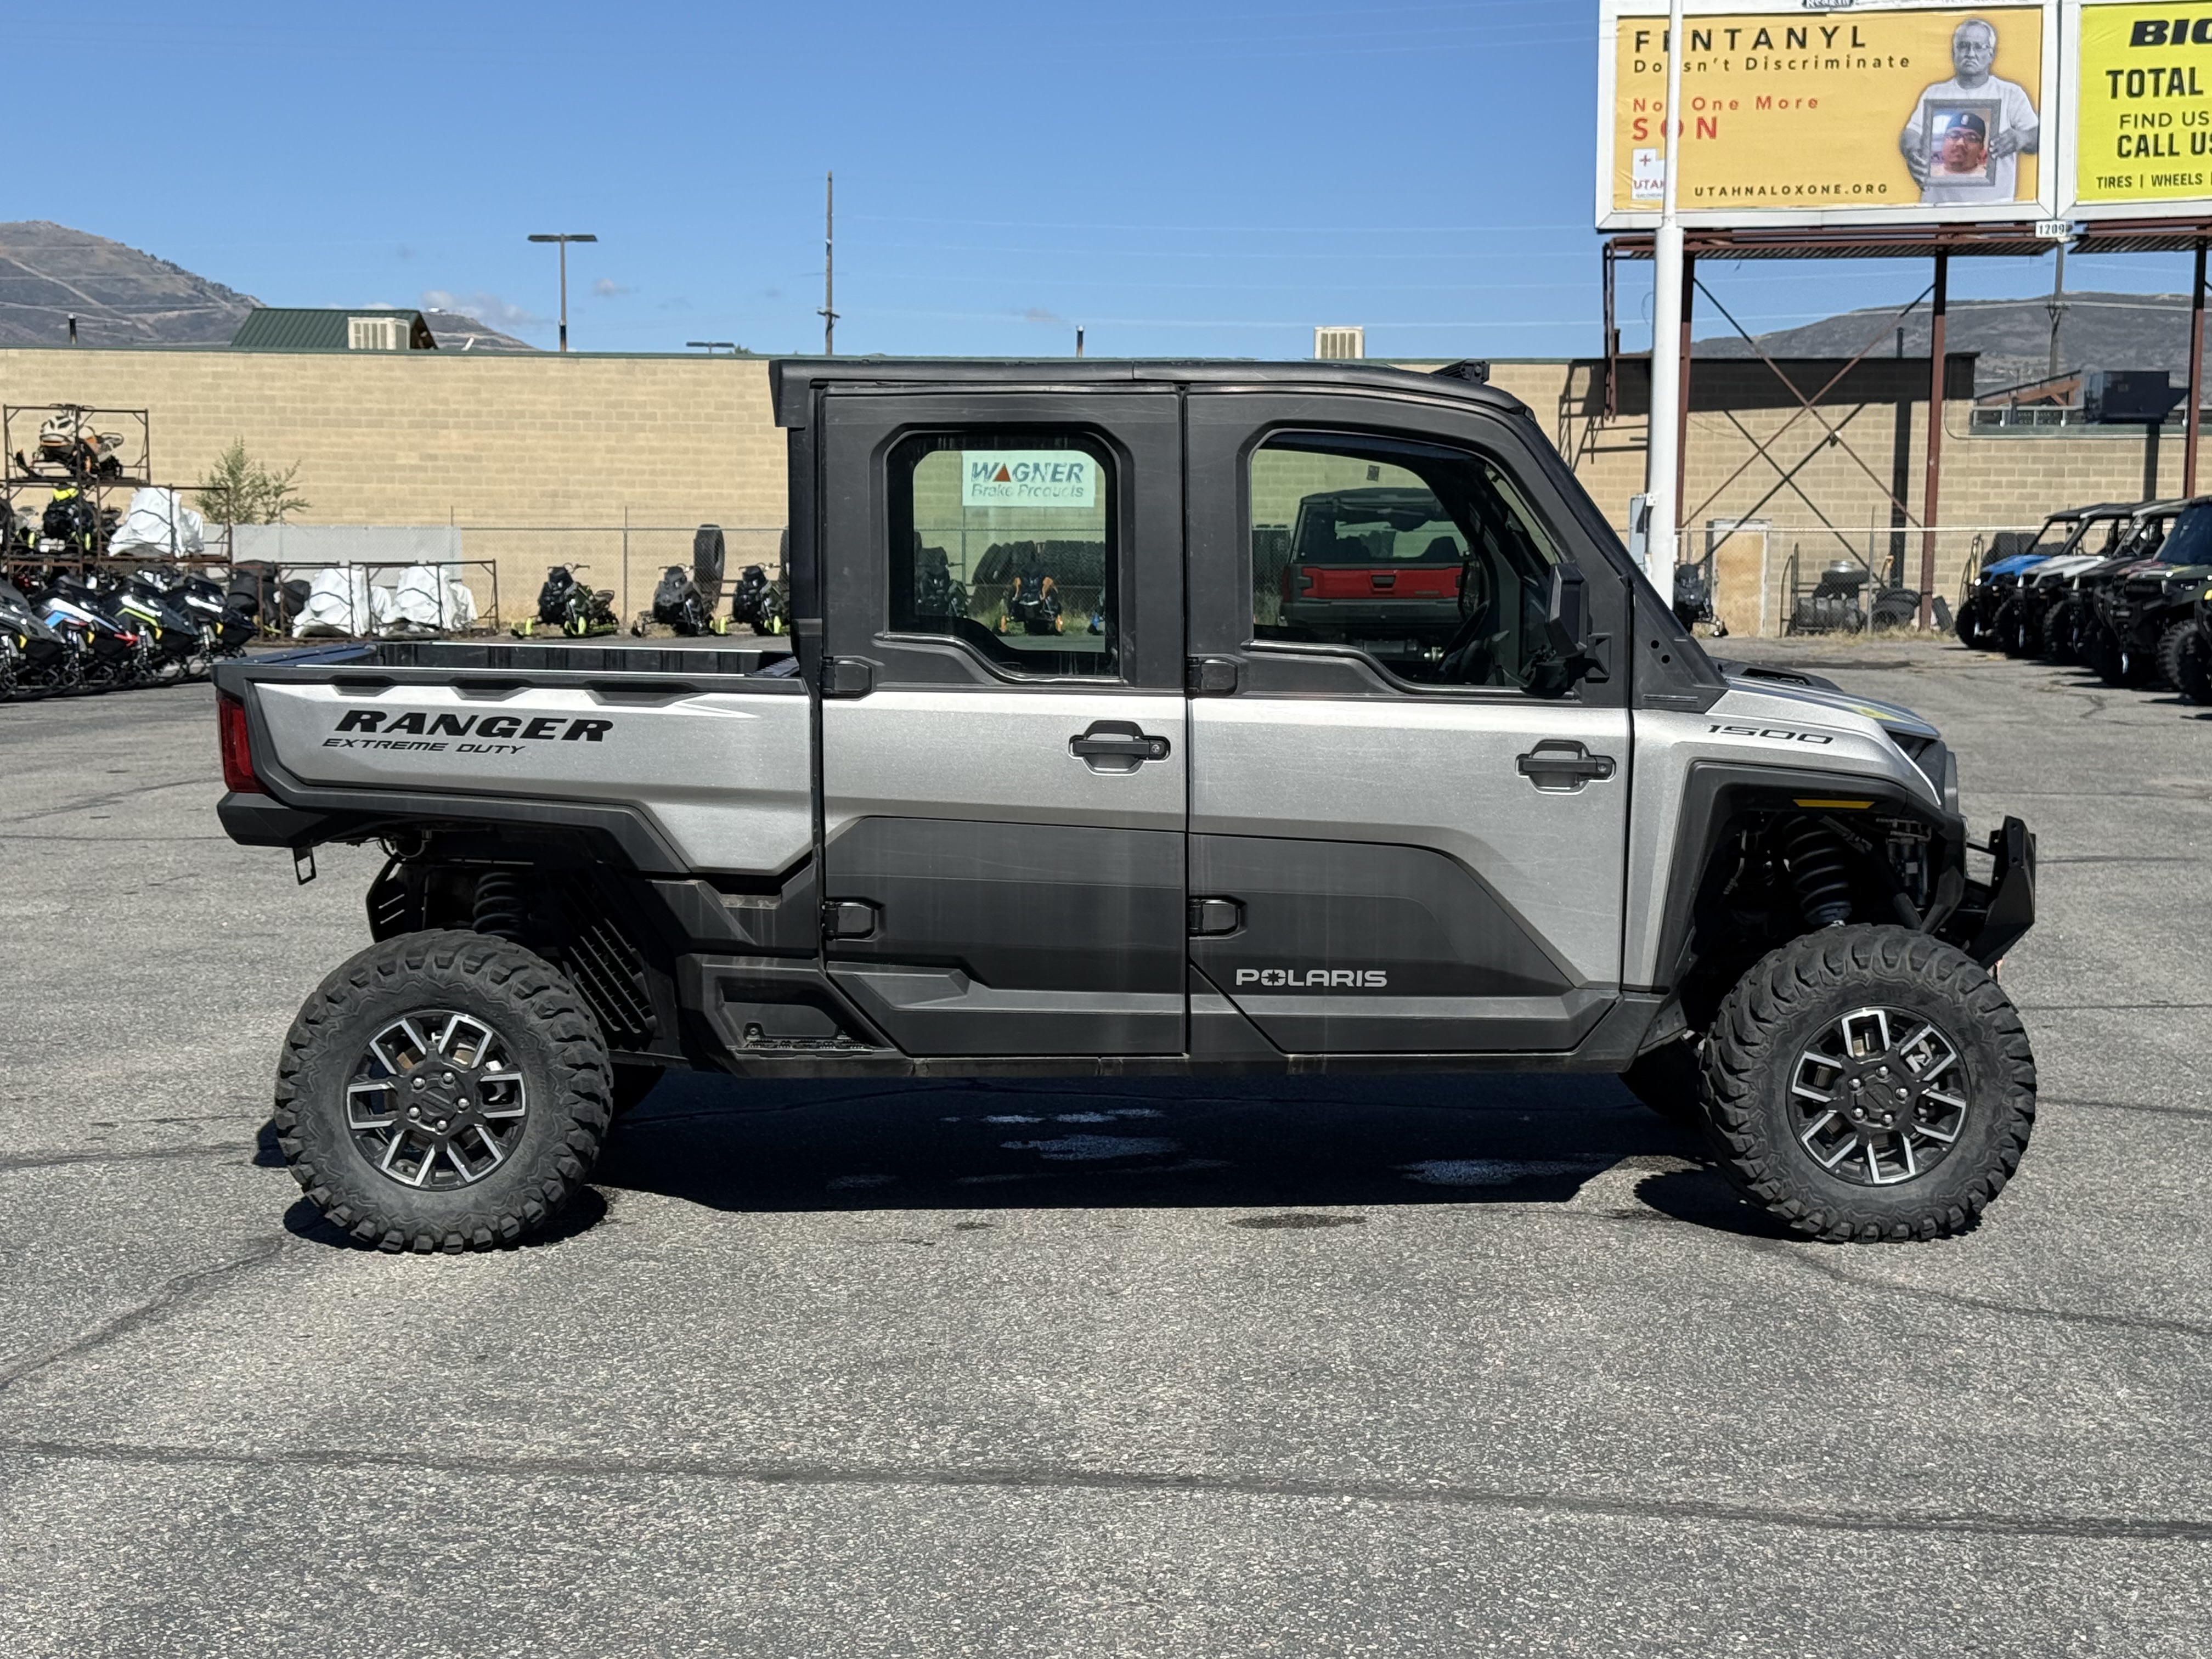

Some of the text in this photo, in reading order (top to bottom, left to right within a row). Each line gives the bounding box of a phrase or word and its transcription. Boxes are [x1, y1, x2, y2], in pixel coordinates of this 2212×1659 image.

[1634, 54, 1910, 73] Dosn't Discriminate
[2106, 66, 2204, 99] TOTAL
[1633, 95, 1819, 112] No One More
[2119, 110, 2210, 129] FIND US
[2117, 132, 2180, 159] CALL
[1694, 184, 1888, 197] UTAHNALOXONE.ORG
[2096, 175, 2133, 190] TIRES
[2151, 172, 2203, 187] WHEELS
[2039, 223, 2065, 235] 1209
[970, 462, 1085, 483] WAGNER
[334, 709, 614, 742] RANGER
[1707, 724, 1834, 744] 1500
[321, 738, 526, 755] EXTREME DUTY
[1235, 968, 1388, 988] POLARIS
